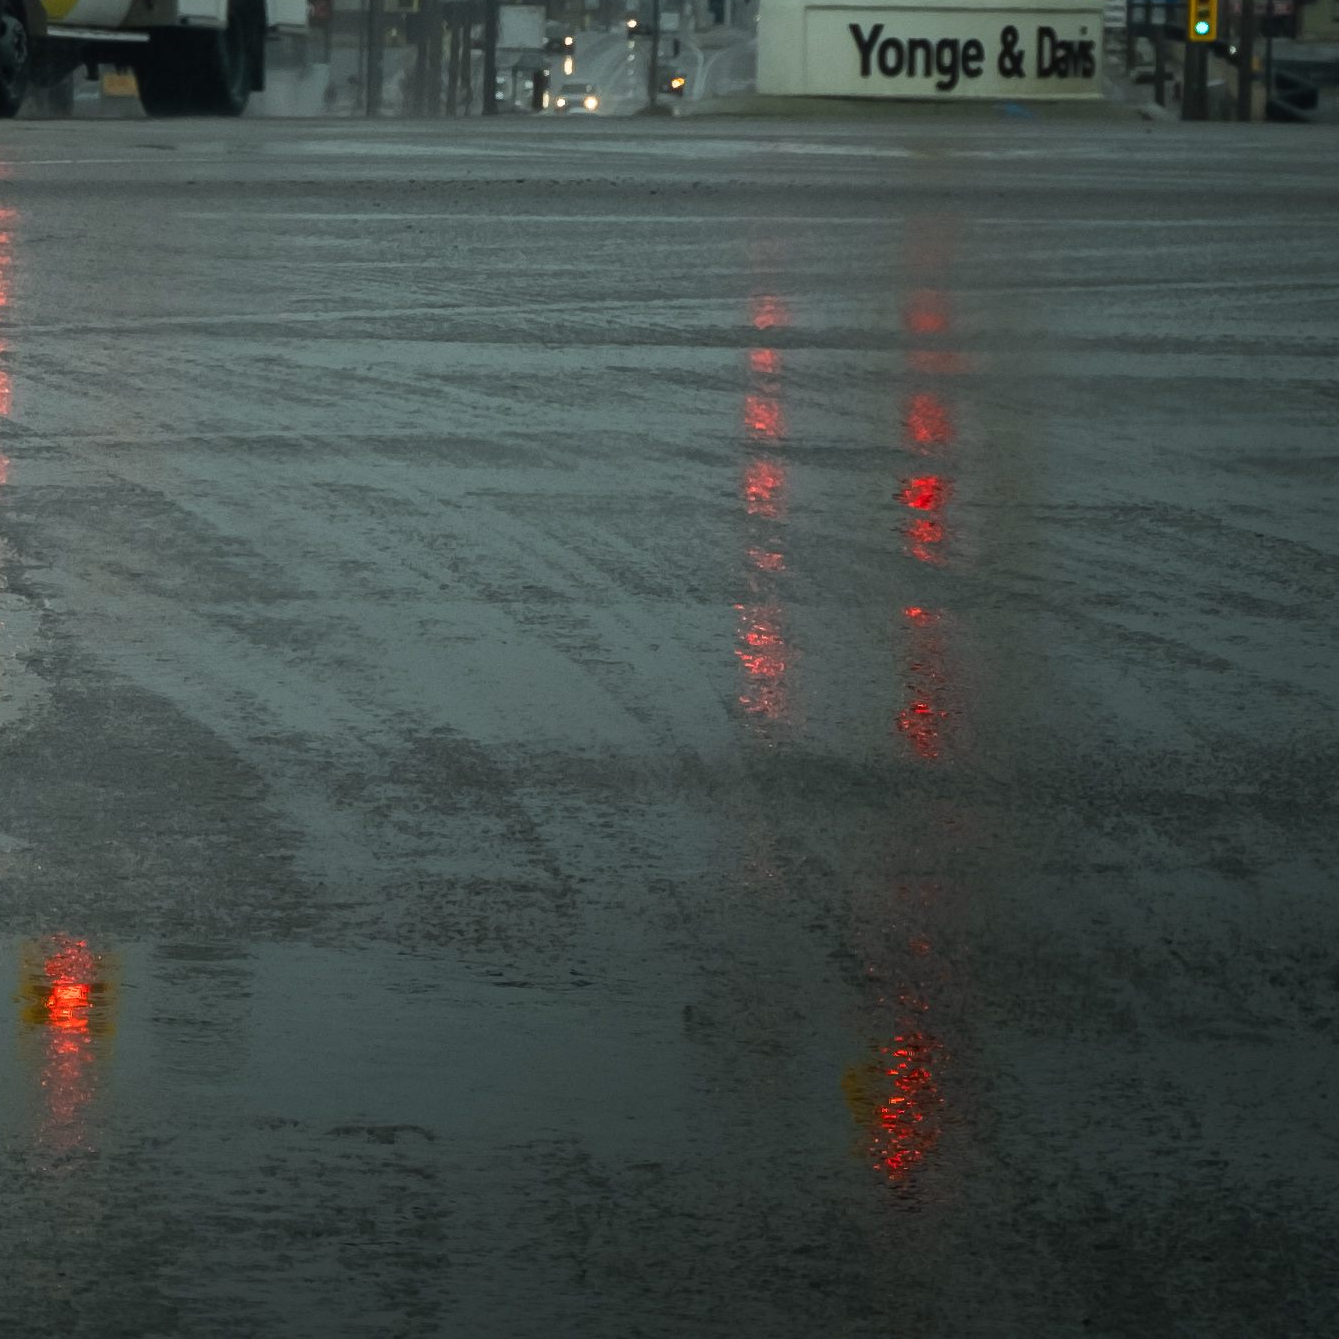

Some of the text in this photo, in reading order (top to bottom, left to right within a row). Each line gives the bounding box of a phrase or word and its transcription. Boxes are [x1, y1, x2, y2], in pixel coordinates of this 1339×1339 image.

[847, 22, 1097, 92] Yonge & Davis
